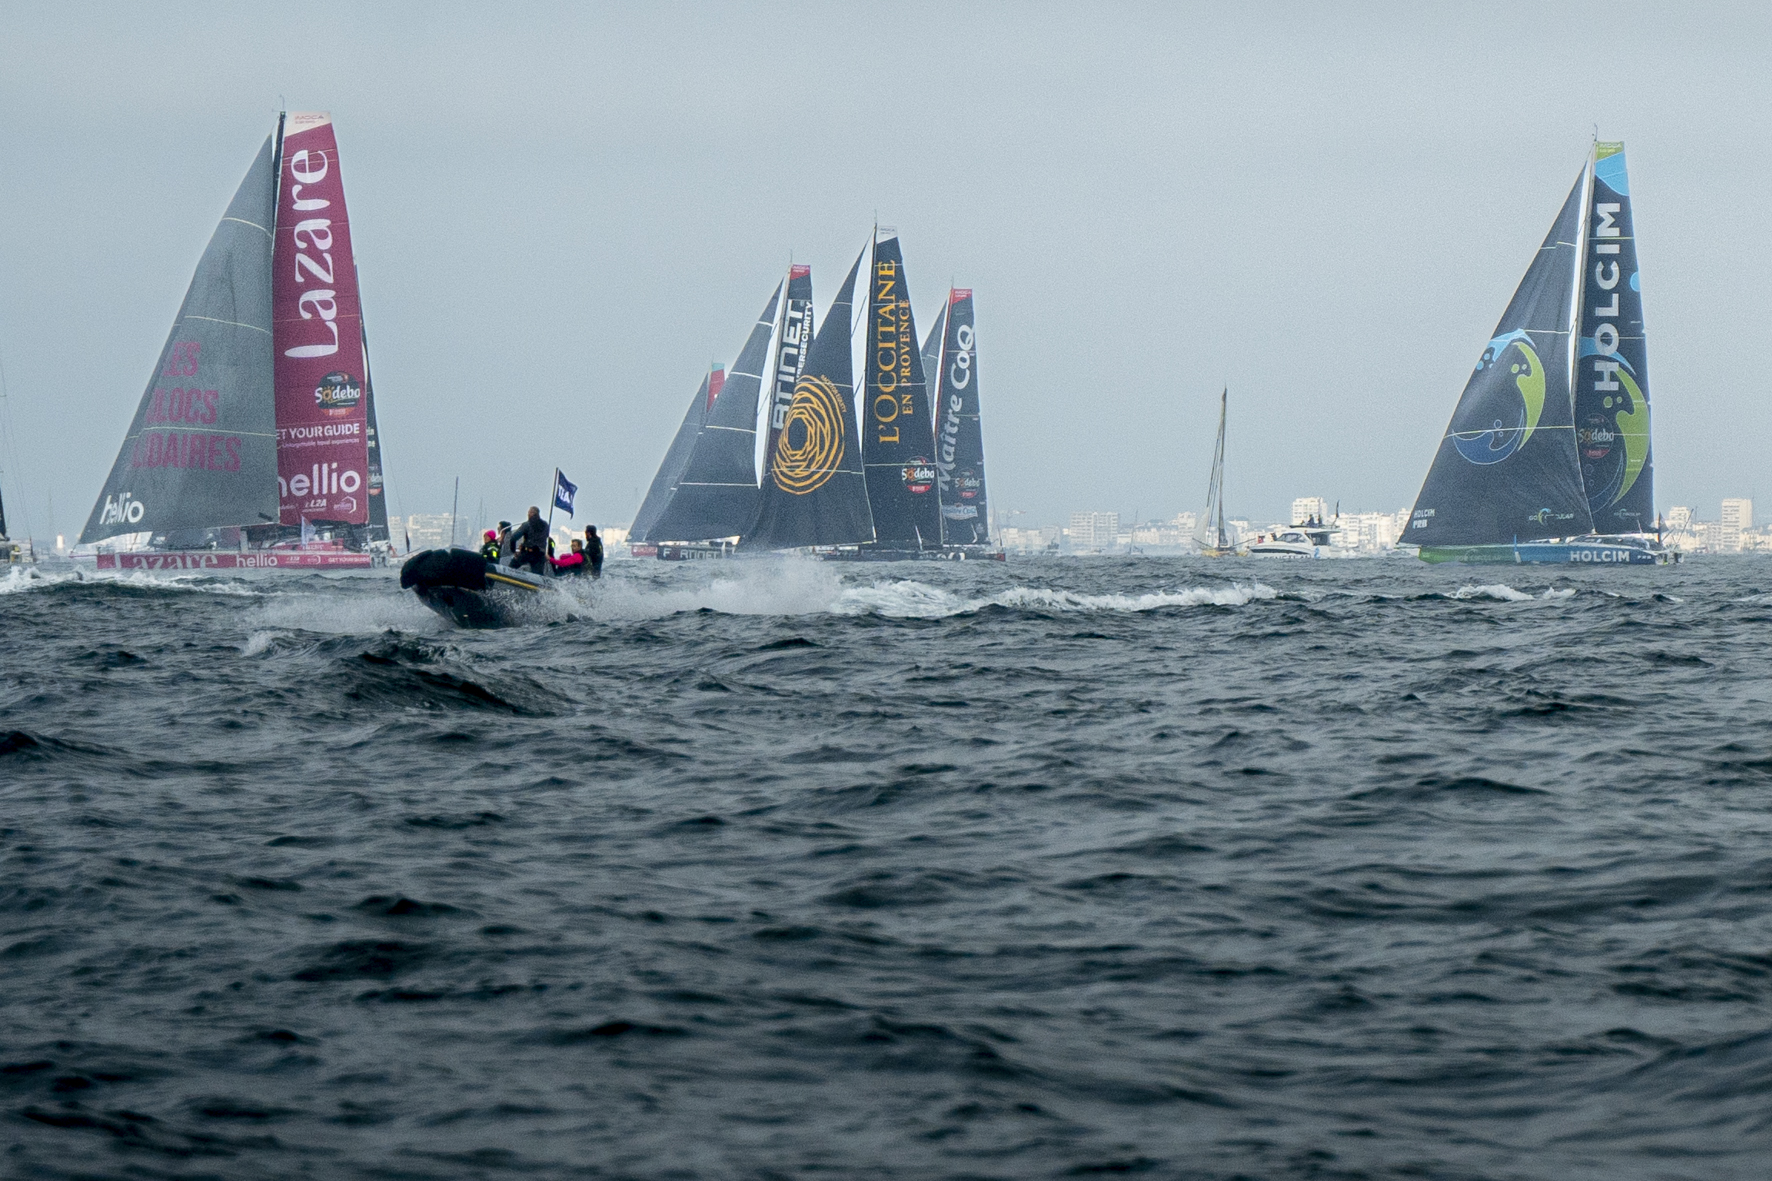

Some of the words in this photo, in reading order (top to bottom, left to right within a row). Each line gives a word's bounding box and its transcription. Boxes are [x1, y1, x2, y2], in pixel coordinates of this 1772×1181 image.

[284, 149, 339, 358] Lazare
[1594, 202, 1621, 391] HOLCIM
[874, 259, 899, 444] L'OCCITANE
[899, 299, 912, 387] PROVENCE
[949, 324, 975, 390] CoQ
[314, 385, 360, 404] Sodebo
[902, 394, 913, 415] EN
[289, 426, 323, 439] YOUR
[324, 423, 360, 436] GUIDE
[938, 394, 963, 492] Maître
[901, 466, 935, 481] Sodebo
[100, 491, 144, 525] hellio
[236, 554, 278, 567] hellio
[1570, 550, 1631, 562] HOLCIM
